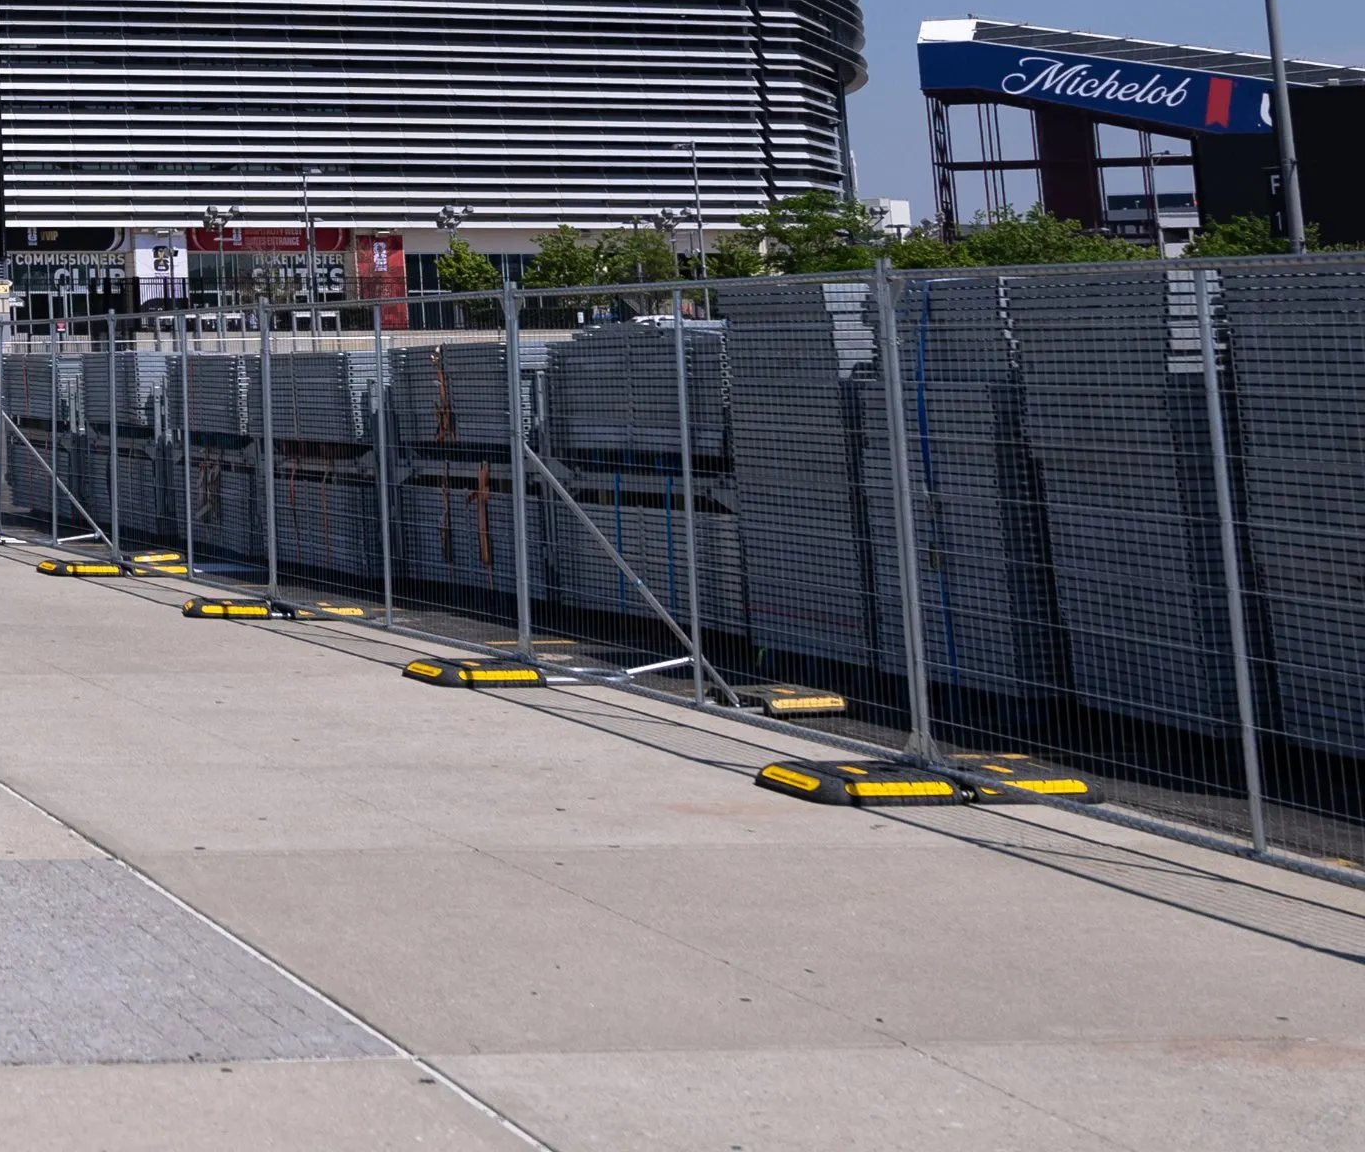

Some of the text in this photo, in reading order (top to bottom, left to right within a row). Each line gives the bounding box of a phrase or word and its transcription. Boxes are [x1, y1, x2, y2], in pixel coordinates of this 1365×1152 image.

[1001, 56, 1192, 108] Michelob
[1270, 174, 1281, 195] F
[1275, 211, 1282, 230] 1
[15, 253, 125, 266] COMMISSIONERS
[254, 253, 344, 265] TICKETMSTER
[53, 268, 126, 295] CLUB
